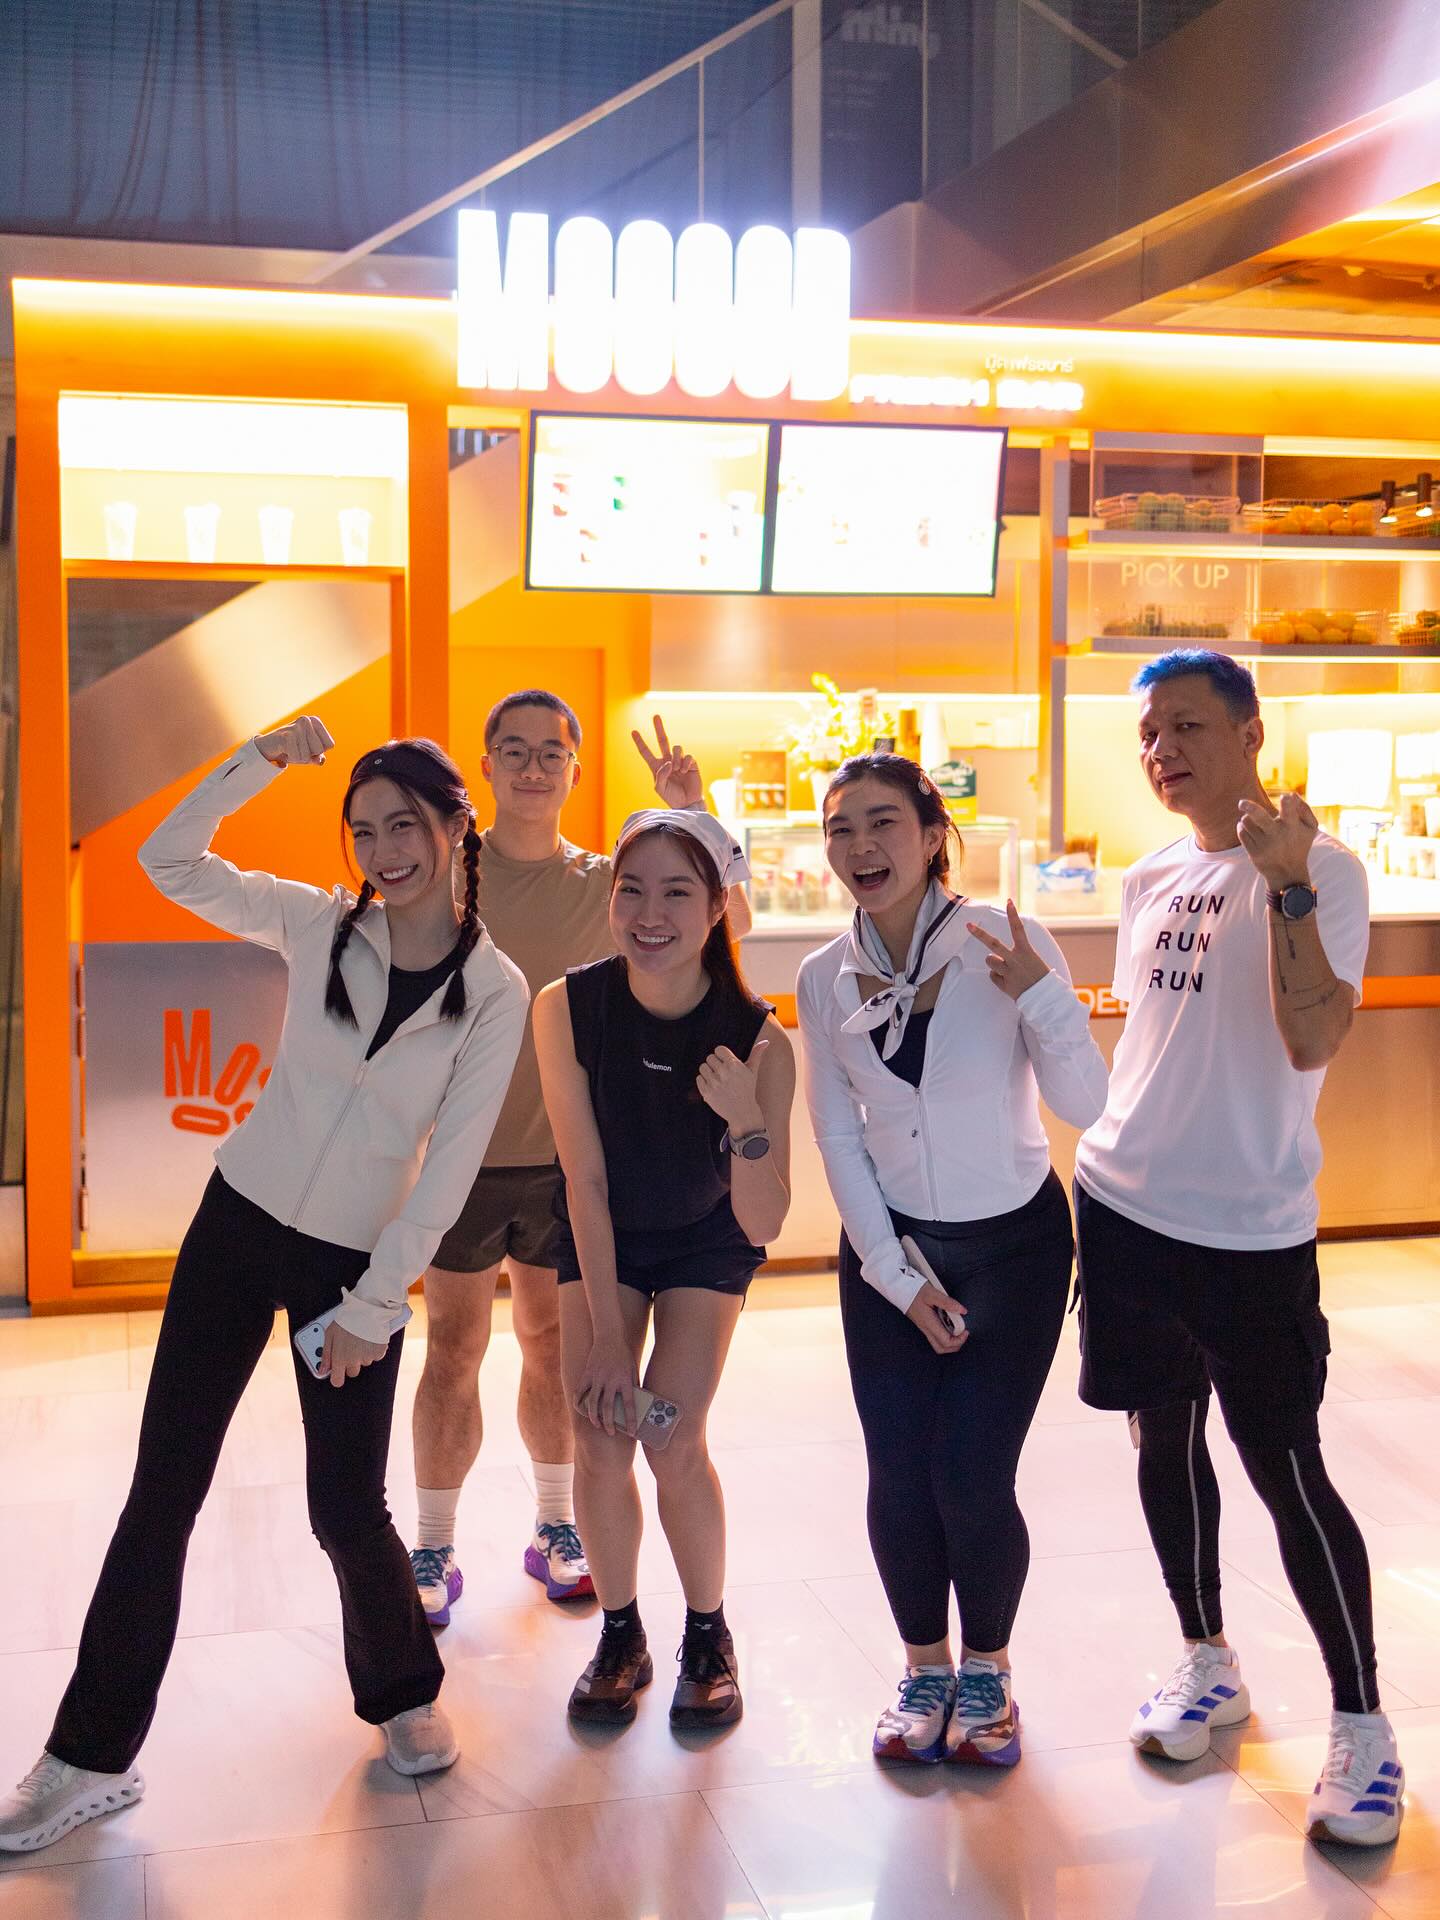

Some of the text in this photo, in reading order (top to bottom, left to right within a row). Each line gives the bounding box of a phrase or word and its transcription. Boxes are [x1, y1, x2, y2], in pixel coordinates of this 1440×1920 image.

[1120, 561, 1231, 590] PICK UP
[1167, 894, 1225, 915] RUN
[1155, 930, 1212, 953] RUN
[1148, 968, 1204, 993] RUN
